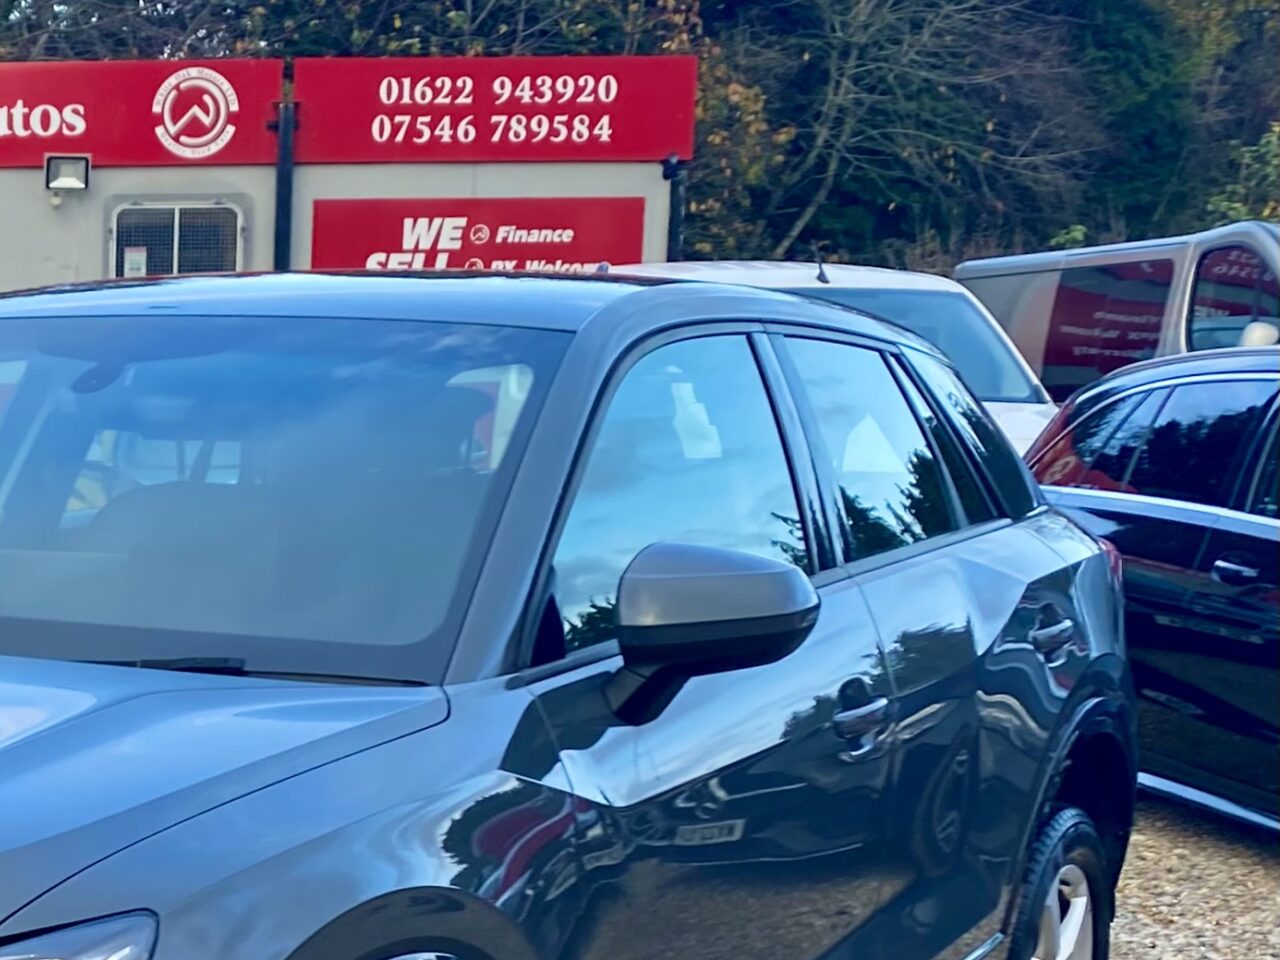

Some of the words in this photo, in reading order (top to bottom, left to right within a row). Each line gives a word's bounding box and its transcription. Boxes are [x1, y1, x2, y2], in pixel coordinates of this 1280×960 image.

[379, 76, 474, 105] 01622
[492, 74, 618, 104] 943920
[371, 114, 477, 143] 07546
[489, 115, 613, 142] 789584
[402, 217, 468, 250] WE
[495, 226, 574, 243] Finance
